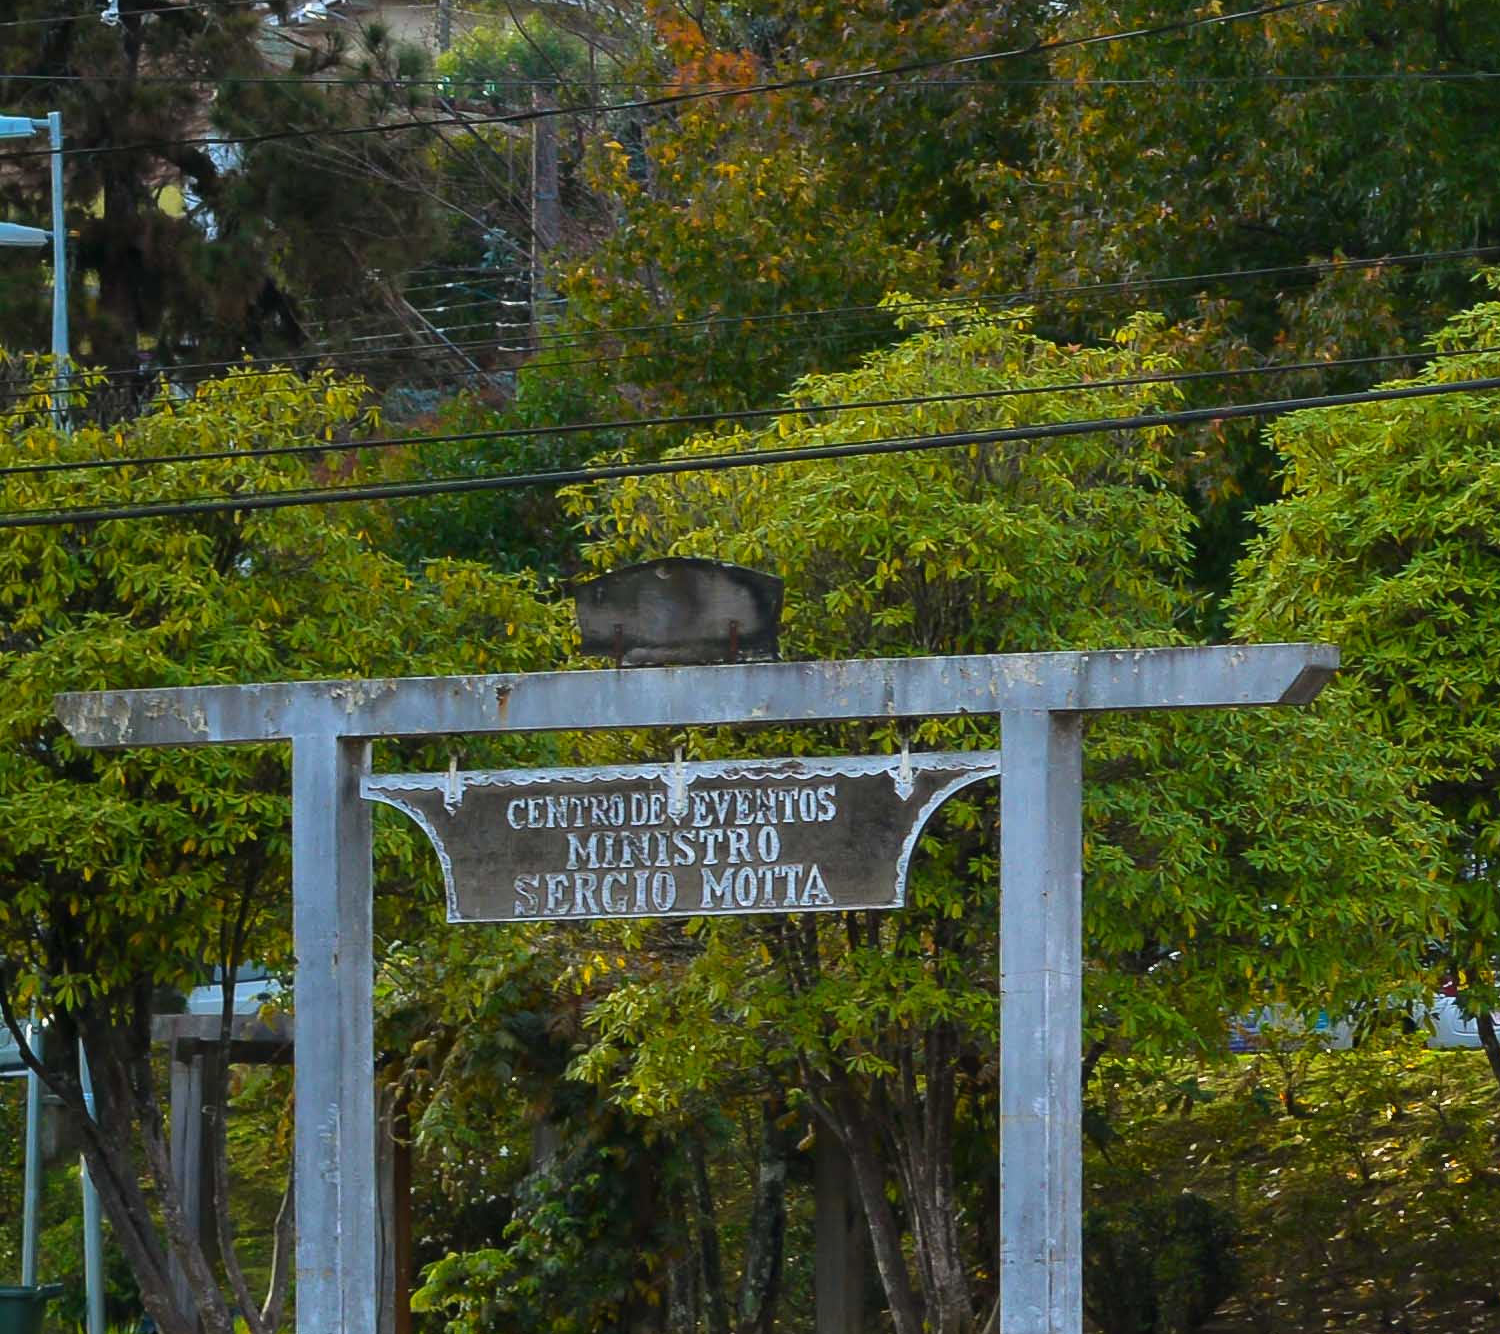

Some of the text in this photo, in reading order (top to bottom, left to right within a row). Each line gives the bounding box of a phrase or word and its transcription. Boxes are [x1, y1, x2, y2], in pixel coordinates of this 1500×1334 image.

[506, 784, 837, 830] CENTRO DE EVENTOS
[565, 825, 781, 870] MINISTRO
[513, 863, 835, 917] SERGIO MOTTA
